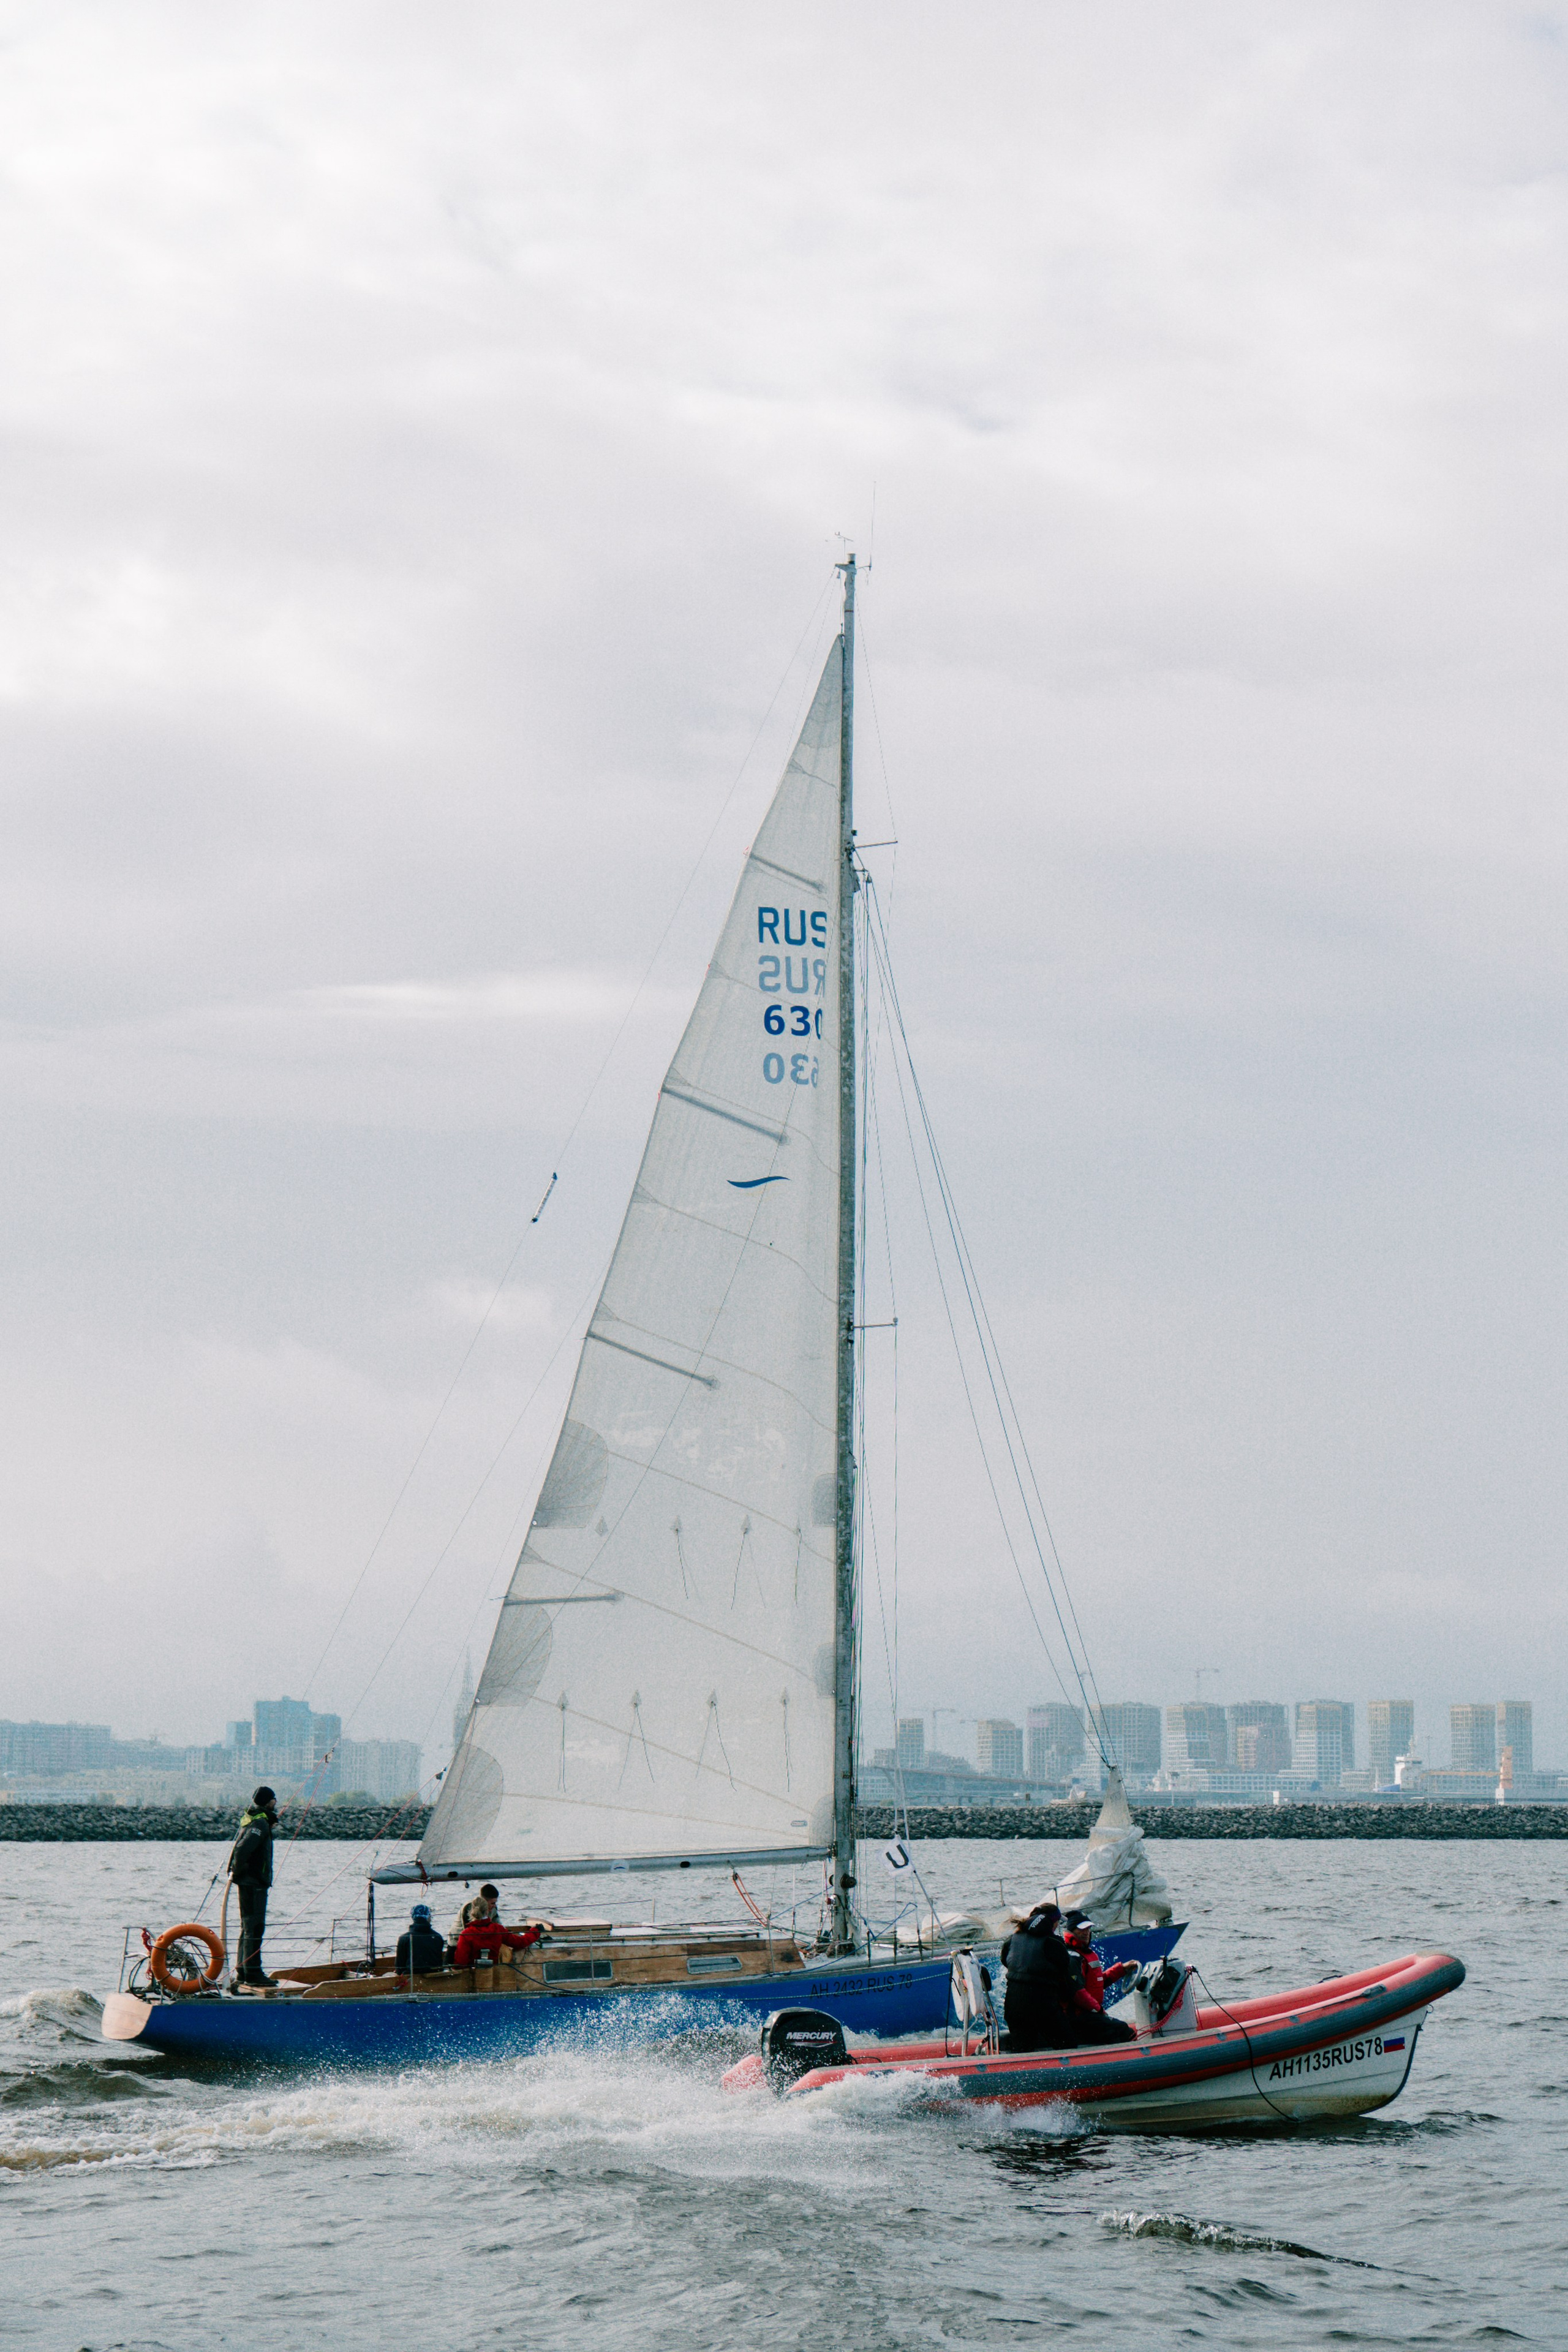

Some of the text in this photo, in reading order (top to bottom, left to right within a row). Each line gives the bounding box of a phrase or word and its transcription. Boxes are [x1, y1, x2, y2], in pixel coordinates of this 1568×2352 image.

[758, 906, 827, 949] RUS
[885, 1844, 910, 1869] U
[810, 1973, 913, 2000] AH 2432 RUS 78
[786, 2031, 837, 2040] MERCURY
[1268, 2036, 1383, 2081] AH1135RUS78
